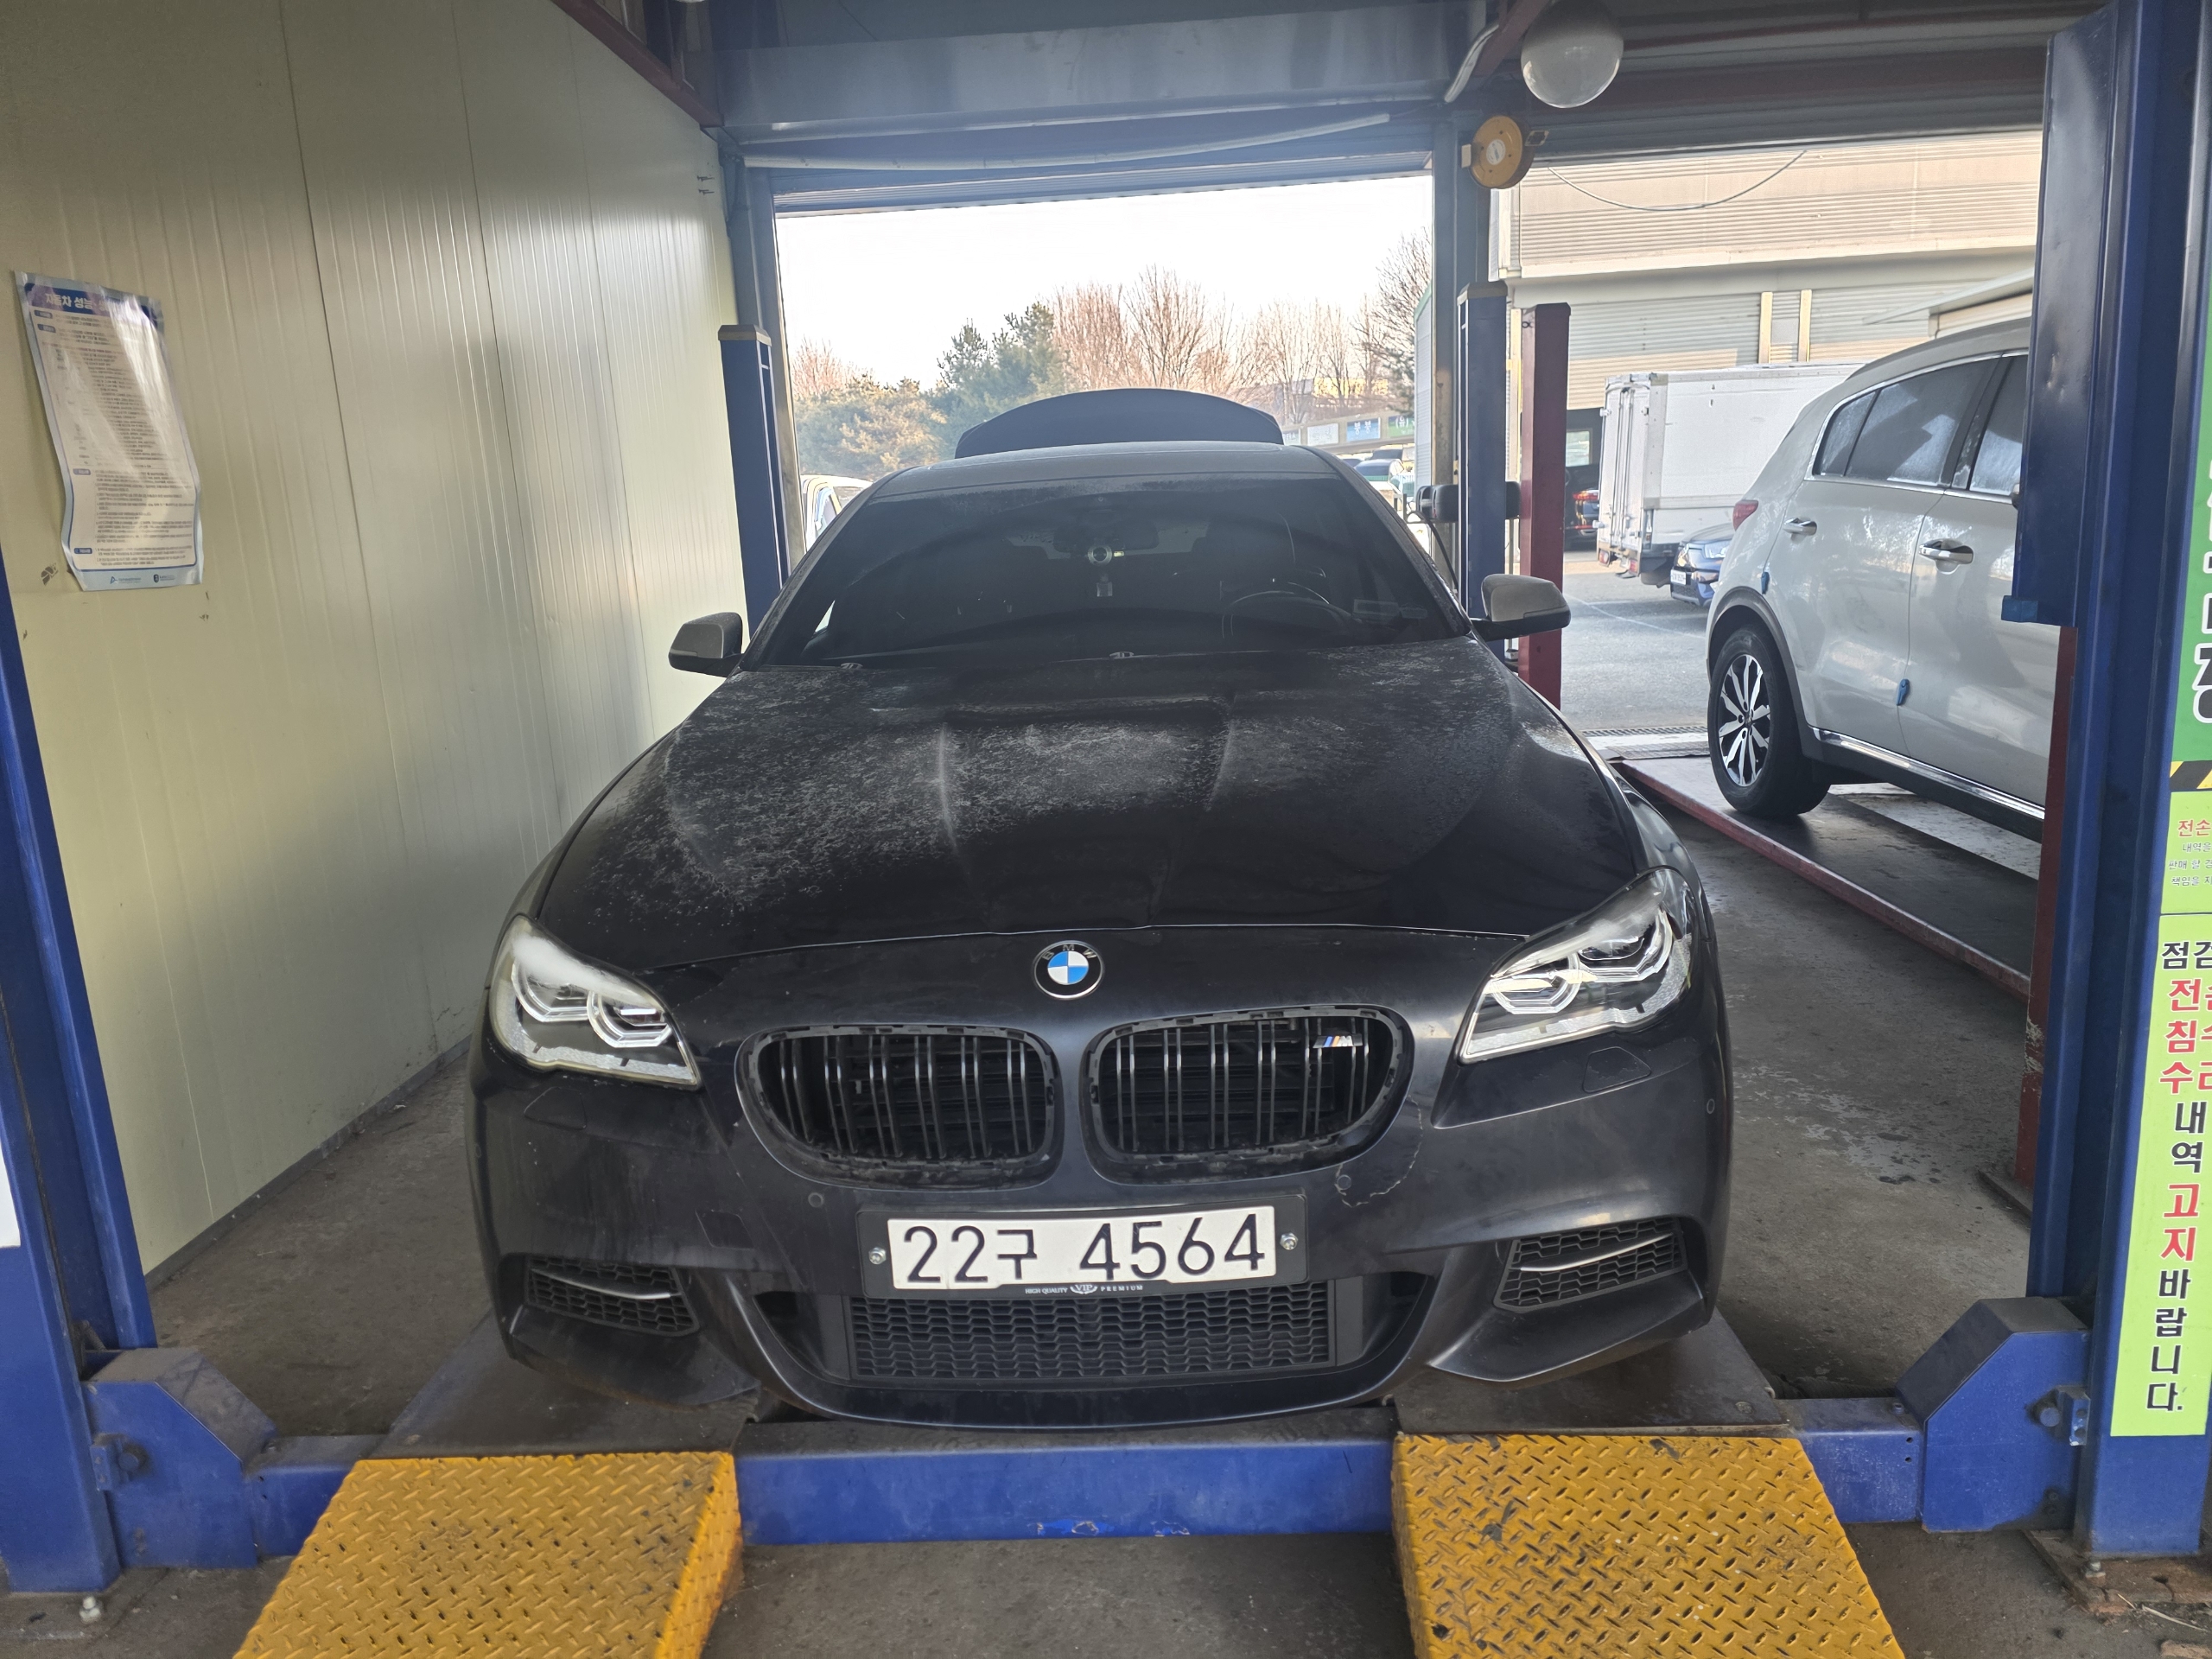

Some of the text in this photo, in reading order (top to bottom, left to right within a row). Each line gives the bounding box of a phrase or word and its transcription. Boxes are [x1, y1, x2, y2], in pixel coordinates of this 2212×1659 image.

[45, 293, 72, 307] 자동차
[2177, 819, 2212, 837] 전손
[2183, 842, 2211, 852] 내역을
[2169, 860, 2187, 869] 판매
[2171, 876, 2200, 887] 책임을
[1042, 944, 1097, 960] BMW
[2168, 978, 2212, 1011] 전
[1337, 1035, 1353, 1047] M
[903, 1213, 1265, 1284] 22구 4564
[2146, 1101, 2207, 1412] 내역 고지 바랍니다.
